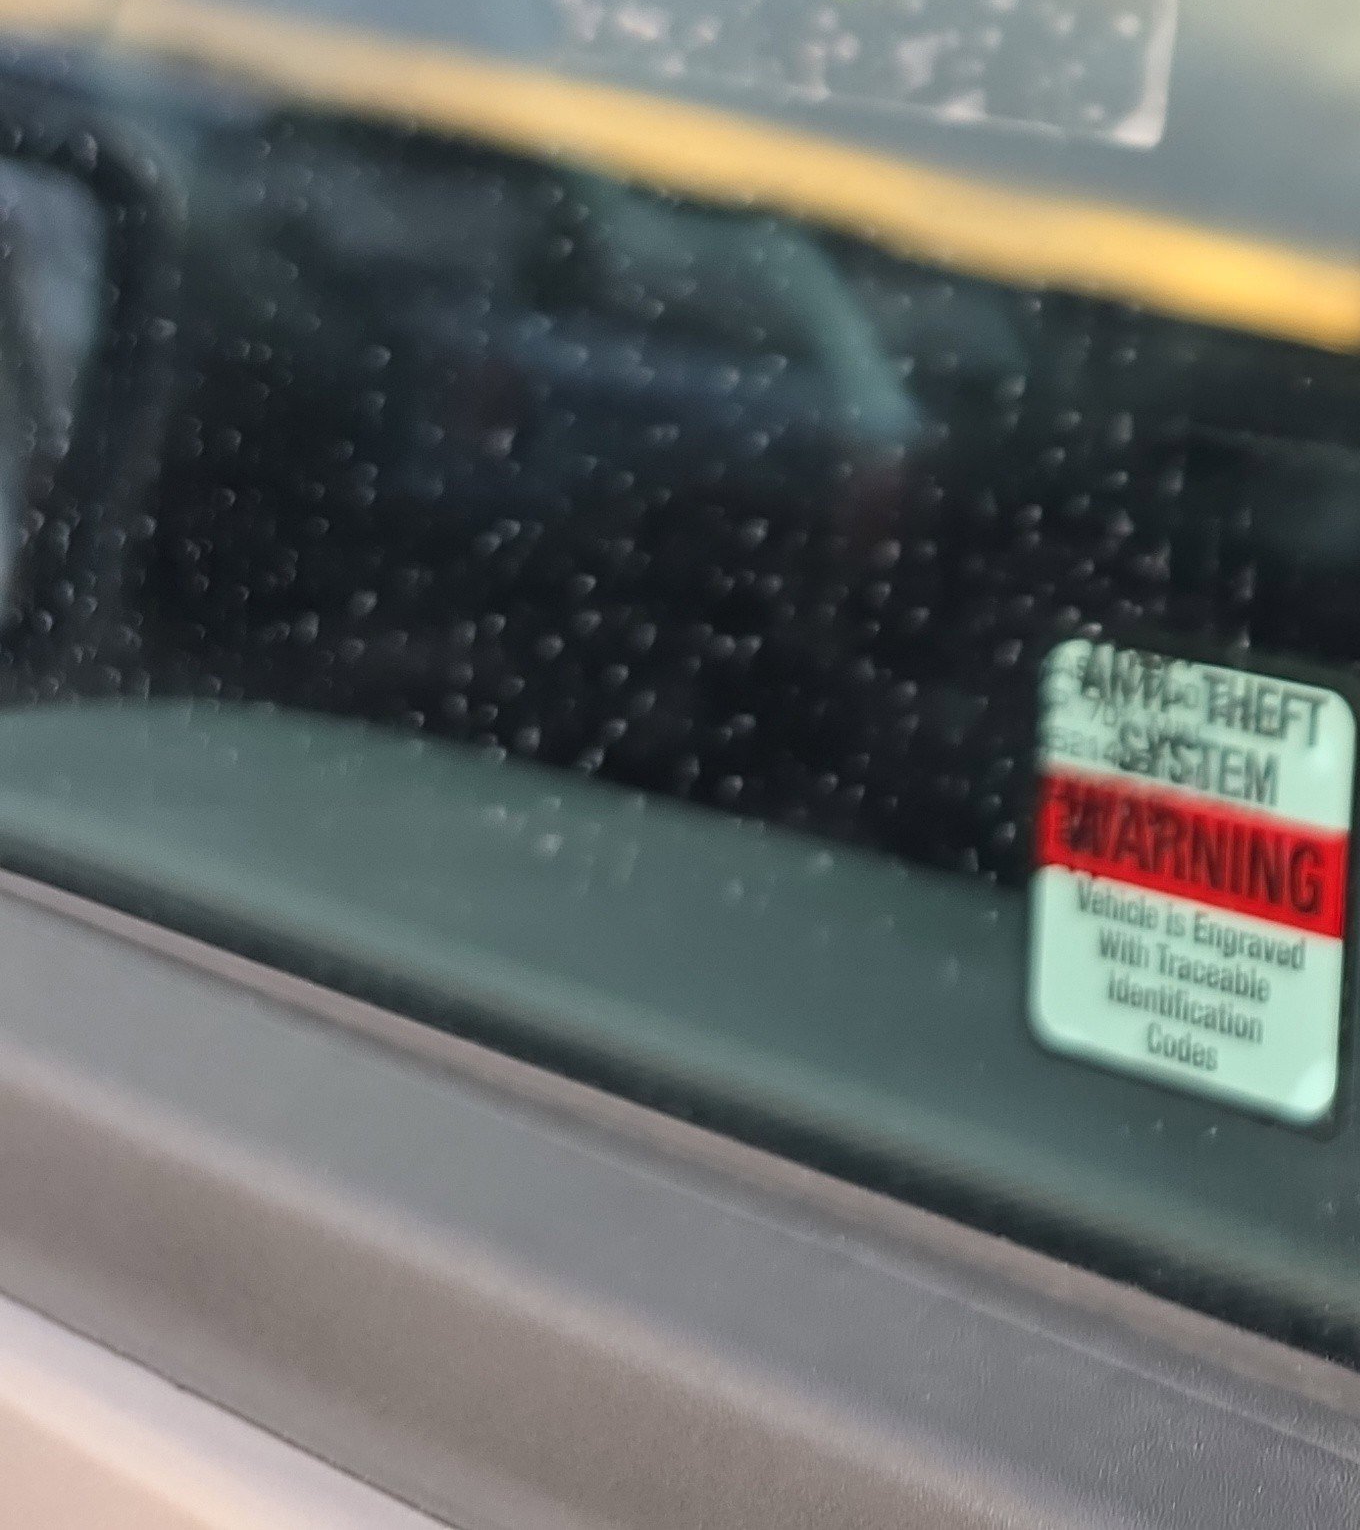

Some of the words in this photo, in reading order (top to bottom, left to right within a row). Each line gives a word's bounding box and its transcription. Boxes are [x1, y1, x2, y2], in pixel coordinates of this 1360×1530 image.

[1118, 718, 1280, 807] SYSTEM
[1063, 778, 1325, 916] WARNING
[1076, 878, 1158, 930] Vehicle
[1165, 905, 1187, 938] is
[1193, 913, 1306, 971] Engraved
[1099, 930, 1150, 970] With
[1156, 942, 1271, 1004] Traceable
[1107, 971, 1264, 1045] Identification
[1145, 1021, 1219, 1071] Codes
